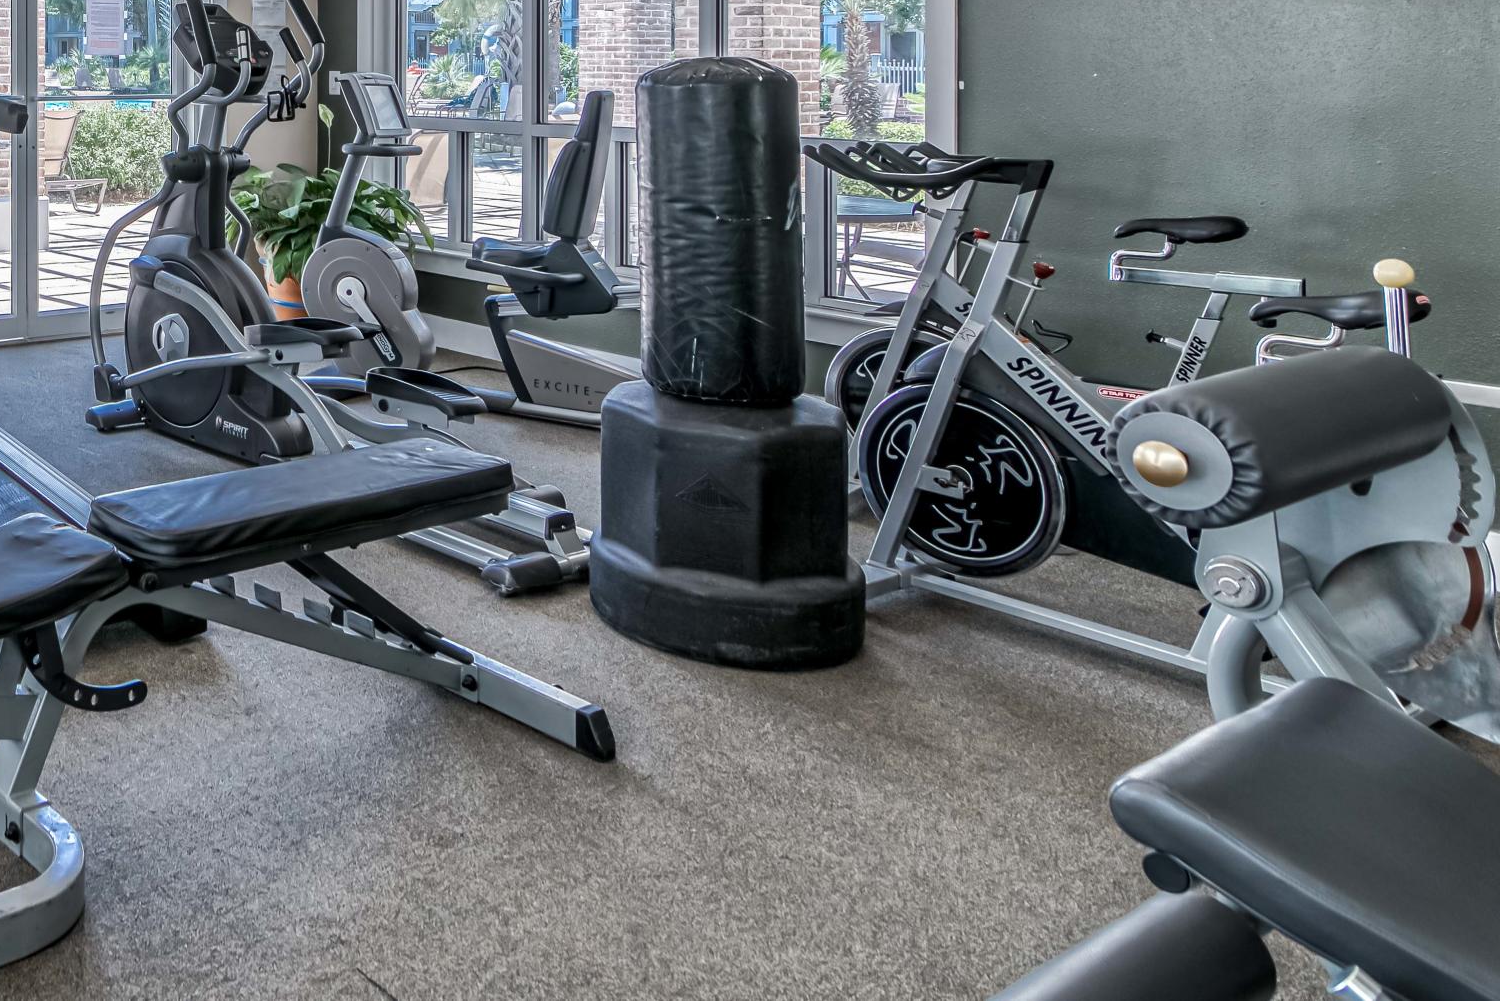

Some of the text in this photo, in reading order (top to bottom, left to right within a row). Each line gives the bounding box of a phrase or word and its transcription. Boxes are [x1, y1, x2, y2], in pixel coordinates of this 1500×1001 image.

[1175, 335, 1208, 383] SPINNER
[533, 378, 592, 396] EXCITE
[1007, 356, 1108, 458] SPINNIN
[223, 420, 249, 435] SPIRIT
